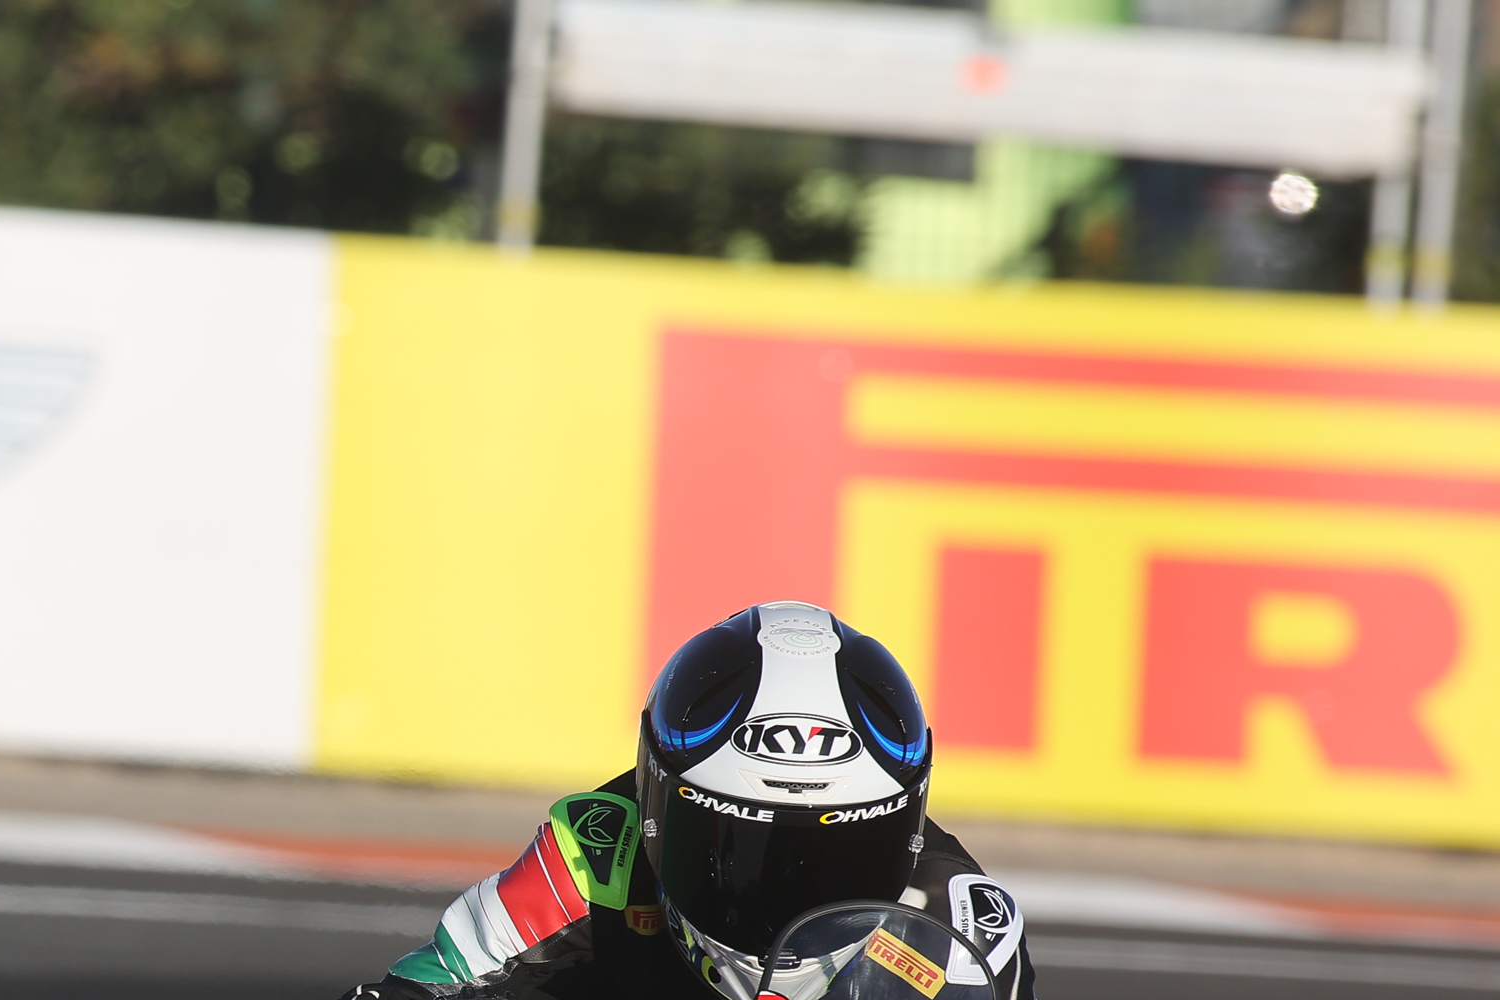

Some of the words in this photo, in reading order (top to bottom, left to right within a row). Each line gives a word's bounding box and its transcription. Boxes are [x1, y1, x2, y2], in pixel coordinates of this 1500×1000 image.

[770, 618, 799, 628] ALPE
[763, 635, 808, 656] MOTORCYCLE
[810, 646, 831, 656] UNION
[744, 724, 851, 757] KYT
[678, 786, 775, 823] OHVALE
[819, 794, 909, 825] OHVALE
[622, 825, 634, 848] VIRUS
[617, 847, 628, 868] POWER
[959, 899, 969, 917] POWER
[865, 930, 939, 989] PIRELLI
